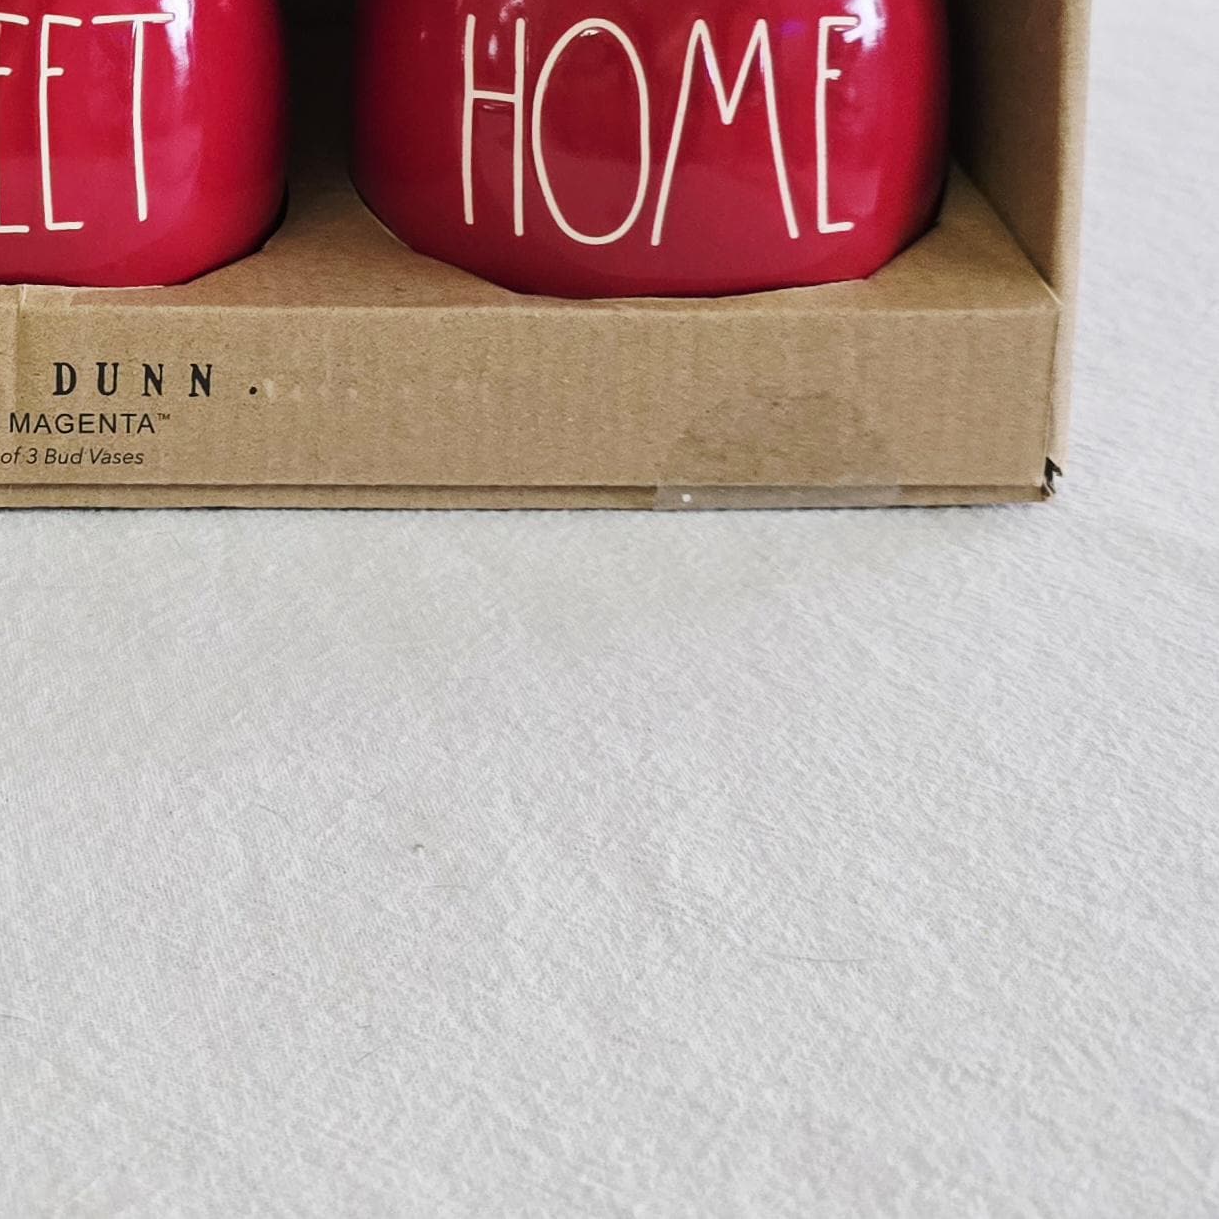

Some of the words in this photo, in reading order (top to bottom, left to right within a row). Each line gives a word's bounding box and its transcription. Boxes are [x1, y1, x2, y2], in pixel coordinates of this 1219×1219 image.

[461, 13, 859, 247] HOME
[0, 447, 20, 465] of
[26, 448, 38, 465] 3
[44, 448, 83, 465] Bud
[89, 448, 144, 465] Vases
